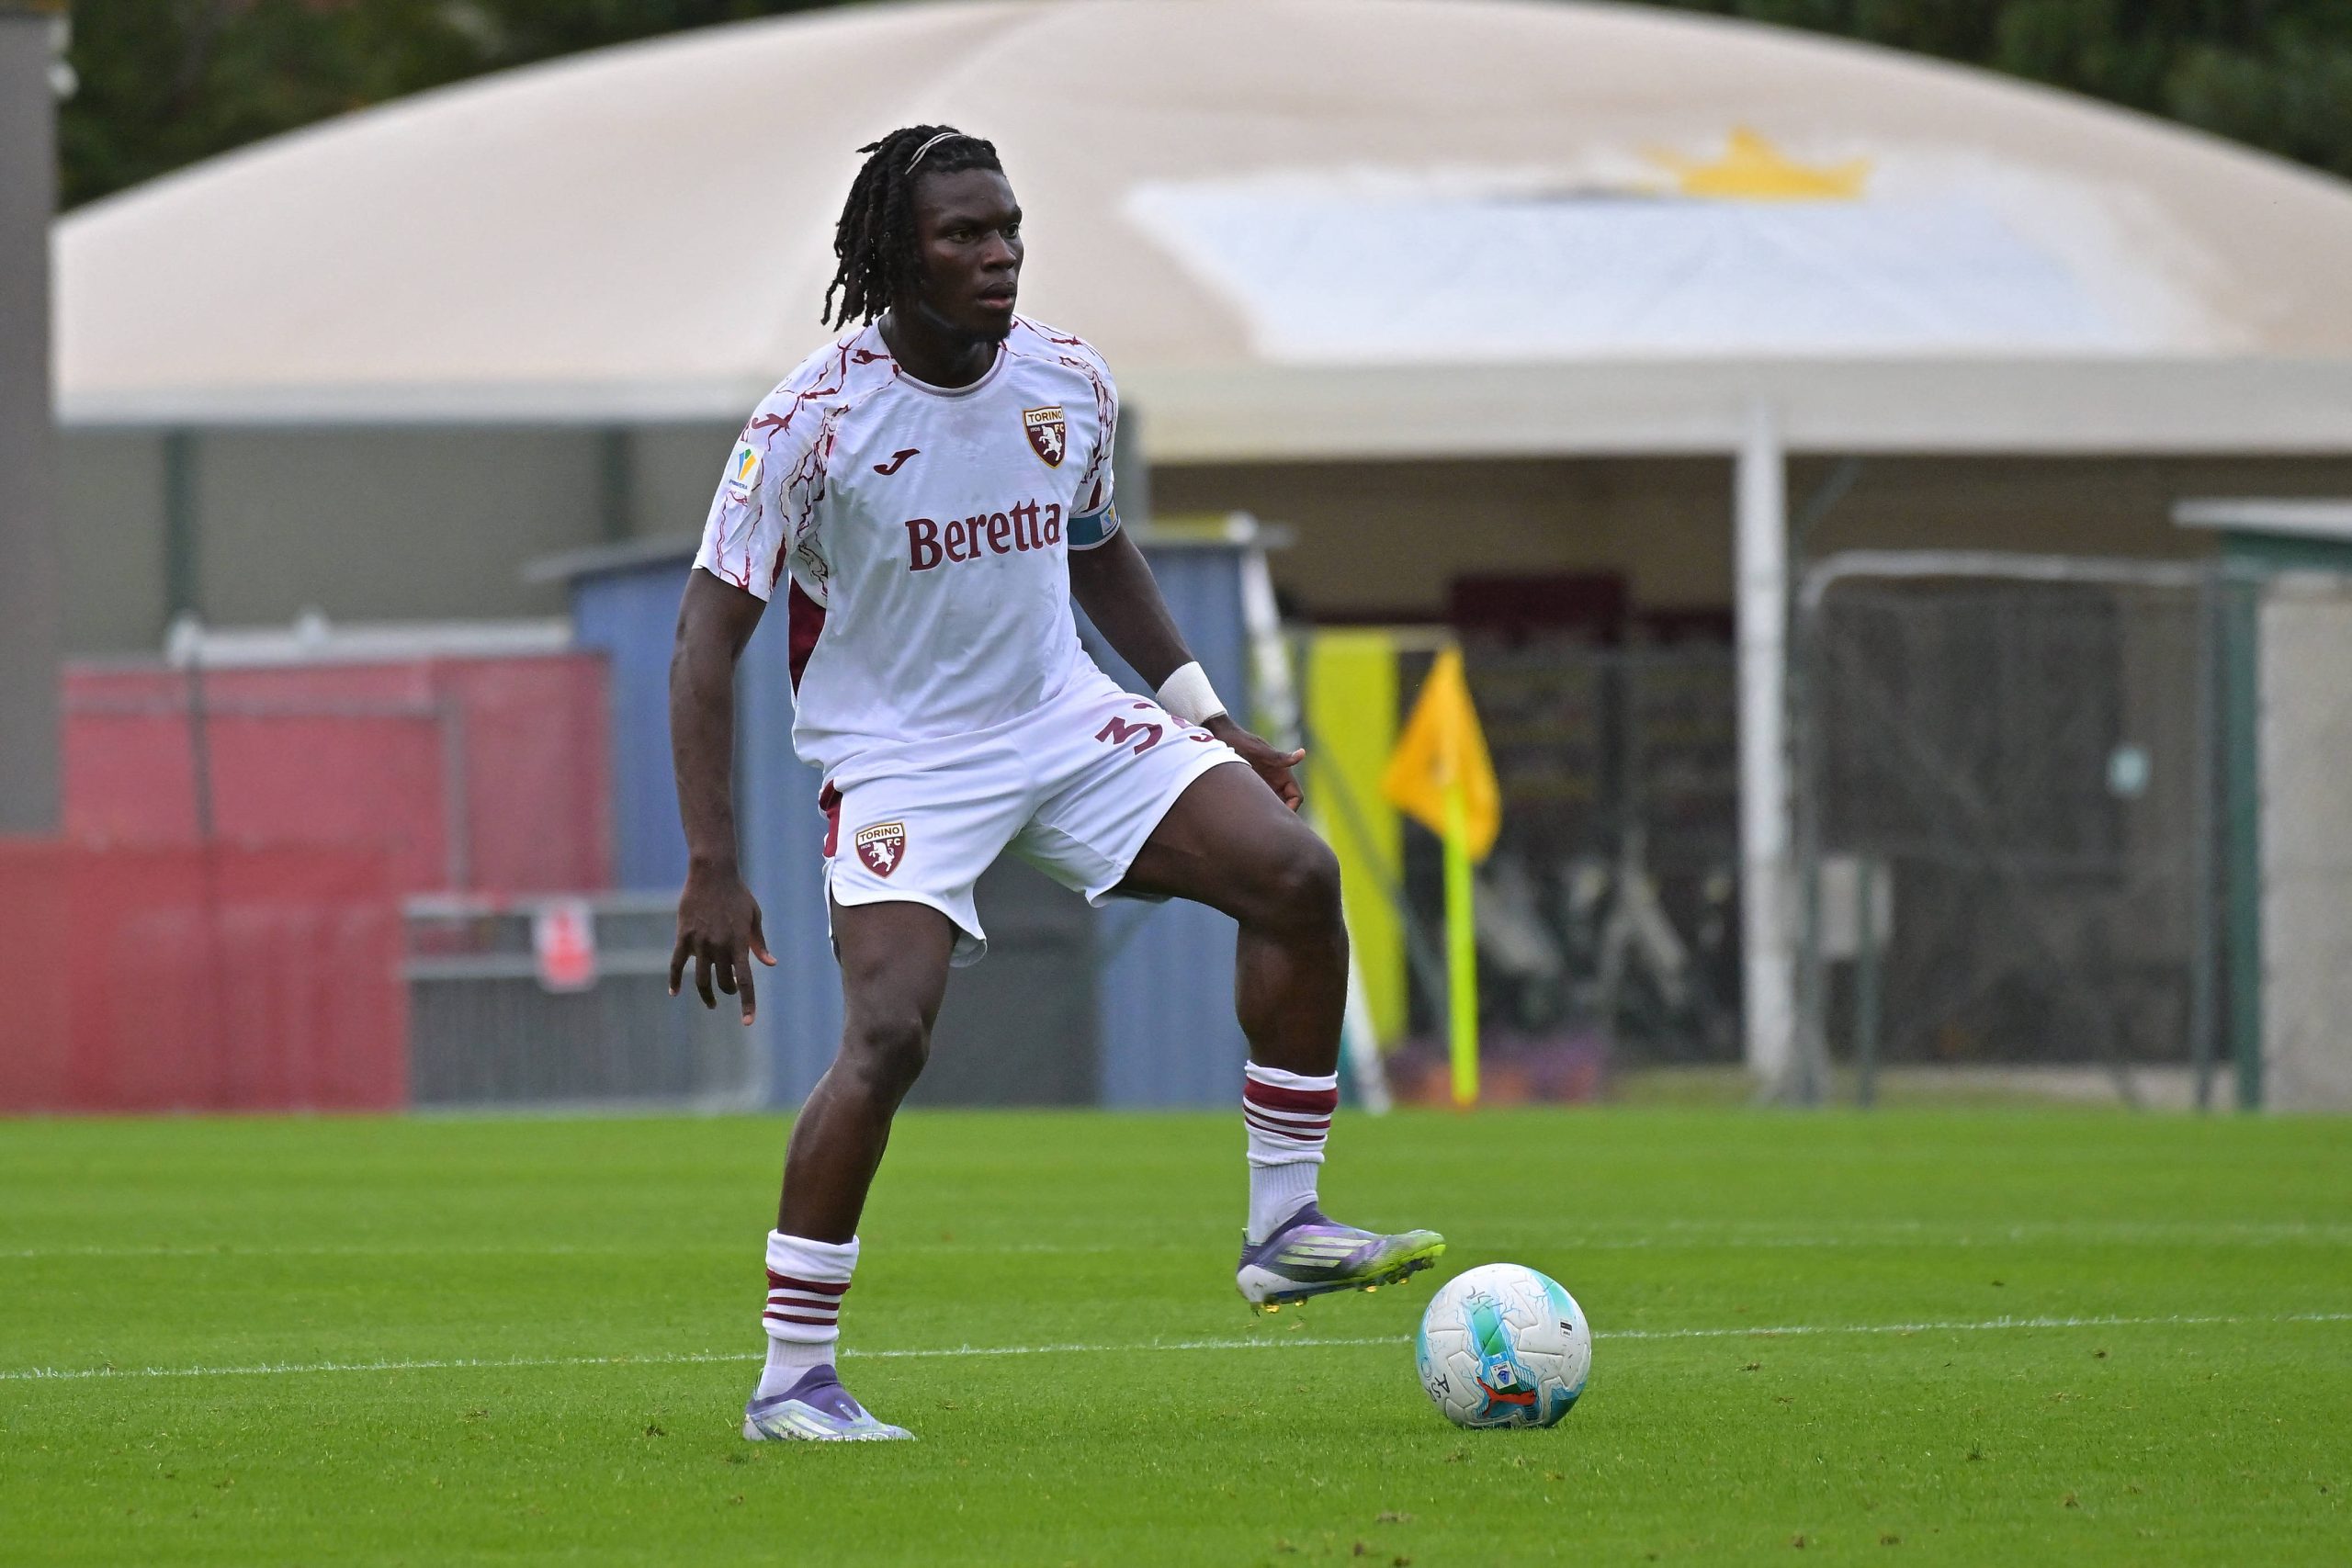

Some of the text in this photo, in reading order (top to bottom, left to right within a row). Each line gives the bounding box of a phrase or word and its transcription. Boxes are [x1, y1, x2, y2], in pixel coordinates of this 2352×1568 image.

[1028, 411, 1063, 423] TORINO
[1054, 423, 1064, 433] FC
[905, 498, 1061, 571] Beretta
[860, 827, 899, 842] TORINO
[887, 838, 901, 848] FC
